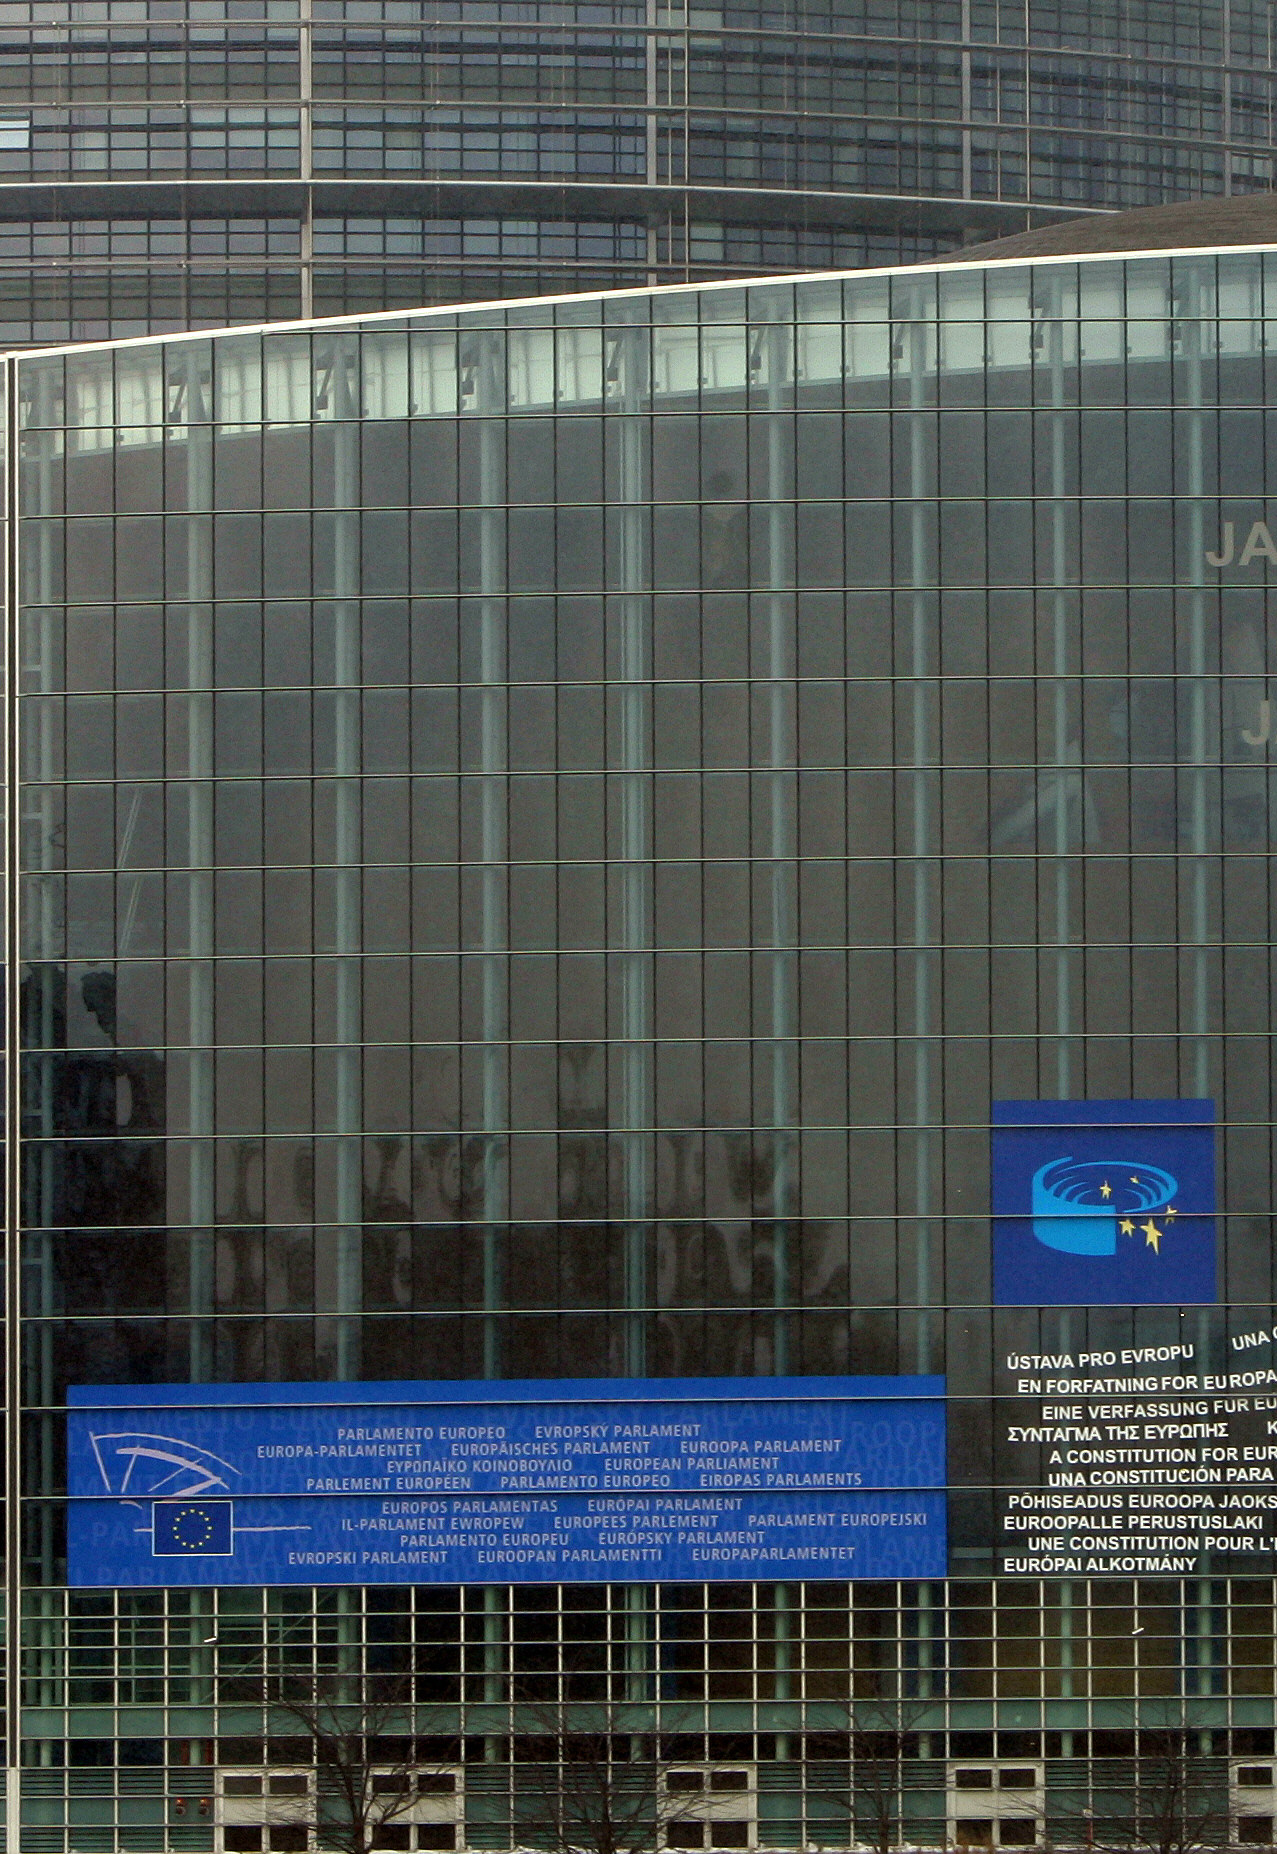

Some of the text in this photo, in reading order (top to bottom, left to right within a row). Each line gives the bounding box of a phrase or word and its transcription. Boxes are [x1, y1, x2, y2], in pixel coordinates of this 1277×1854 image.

[1232, 1330, 1270, 1351] UNA
[1007, 1344, 1195, 1370] ÚSTAVA PRO EVROPU
[1017, 1379, 1042, 1393] EN
[1046, 1377, 1159, 1393] FORFATNING
[1161, 1375, 1199, 1391] FOR
[1042, 1405, 1082, 1420] EINE
[1088, 1400, 1209, 1419] VERFASSUNG
[338, 1427, 433, 1440] PARLAMENTO
[440, 1426, 505, 1439] EUROPEO
[614, 1424, 700, 1437] PARLAMENT
[1008, 1427, 1102, 1442] ΣΥΝΤΑΓΜΑ
[1105, 1426, 1140, 1440] ΤΗΣ
[257, 1439, 841, 1458] EUROPA-PARLAMENTET EUROPÄISCHES PARLAMENT EUROOPA PARLAMENT
[1049, 1450, 1063, 1464] A
[1066, 1448, 1197, 1464] CONSTITUTION
[1201, 1446, 1239, 1462] FOR
[605, 1456, 779, 1471] EUROPEAN PARLIAMENT
[307, 1477, 392, 1491] PARLEMENT
[396, 1474, 471, 1490] EUROPÉEN
[501, 1475, 597, 1488] PARLAMENTO
[603, 1474, 670, 1487] EUROPEO
[700, 1473, 761, 1486] EIROPAS
[767, 1472, 861, 1486] PARLAMENTS
[1049, 1471, 1086, 1487] UNA
[1089, 1465, 1221, 1486] CONSTITUCIÓN
[1226, 1467, 1274, 1482] PARA
[383, 1501, 443, 1515] EUROPOS
[449, 1500, 557, 1513] PARLAMENTAS
[656, 1499, 742, 1511] PARLAMENT
[1128, 1494, 1215, 1509] EUROOPA
[343, 1513, 927, 1532] IL-PARLAMENT EWROPEW EUROPEES PARLEMENT PARLAMENT EUROPEJSKI
[1004, 1515, 1263, 1530] EUROOPALLE PERUSTUSLAKI
[401, 1535, 497, 1547] PARLAMENTO
[503, 1534, 568, 1546] EUROPEU
[678, 1532, 764, 1544] PARLAMENT
[1028, 1537, 1065, 1551] UNE
[1069, 1536, 1199, 1551] CONSTITUTION
[1205, 1537, 1254, 1551] POUR
[288, 1547, 854, 1565] EVROPSKI PARLAMENT EUROOPAN PARLAMENTTI EUROPAPARLAMENTET
[1004, 1554, 1197, 1572] EURÓPAI ALKOTMÁNY
